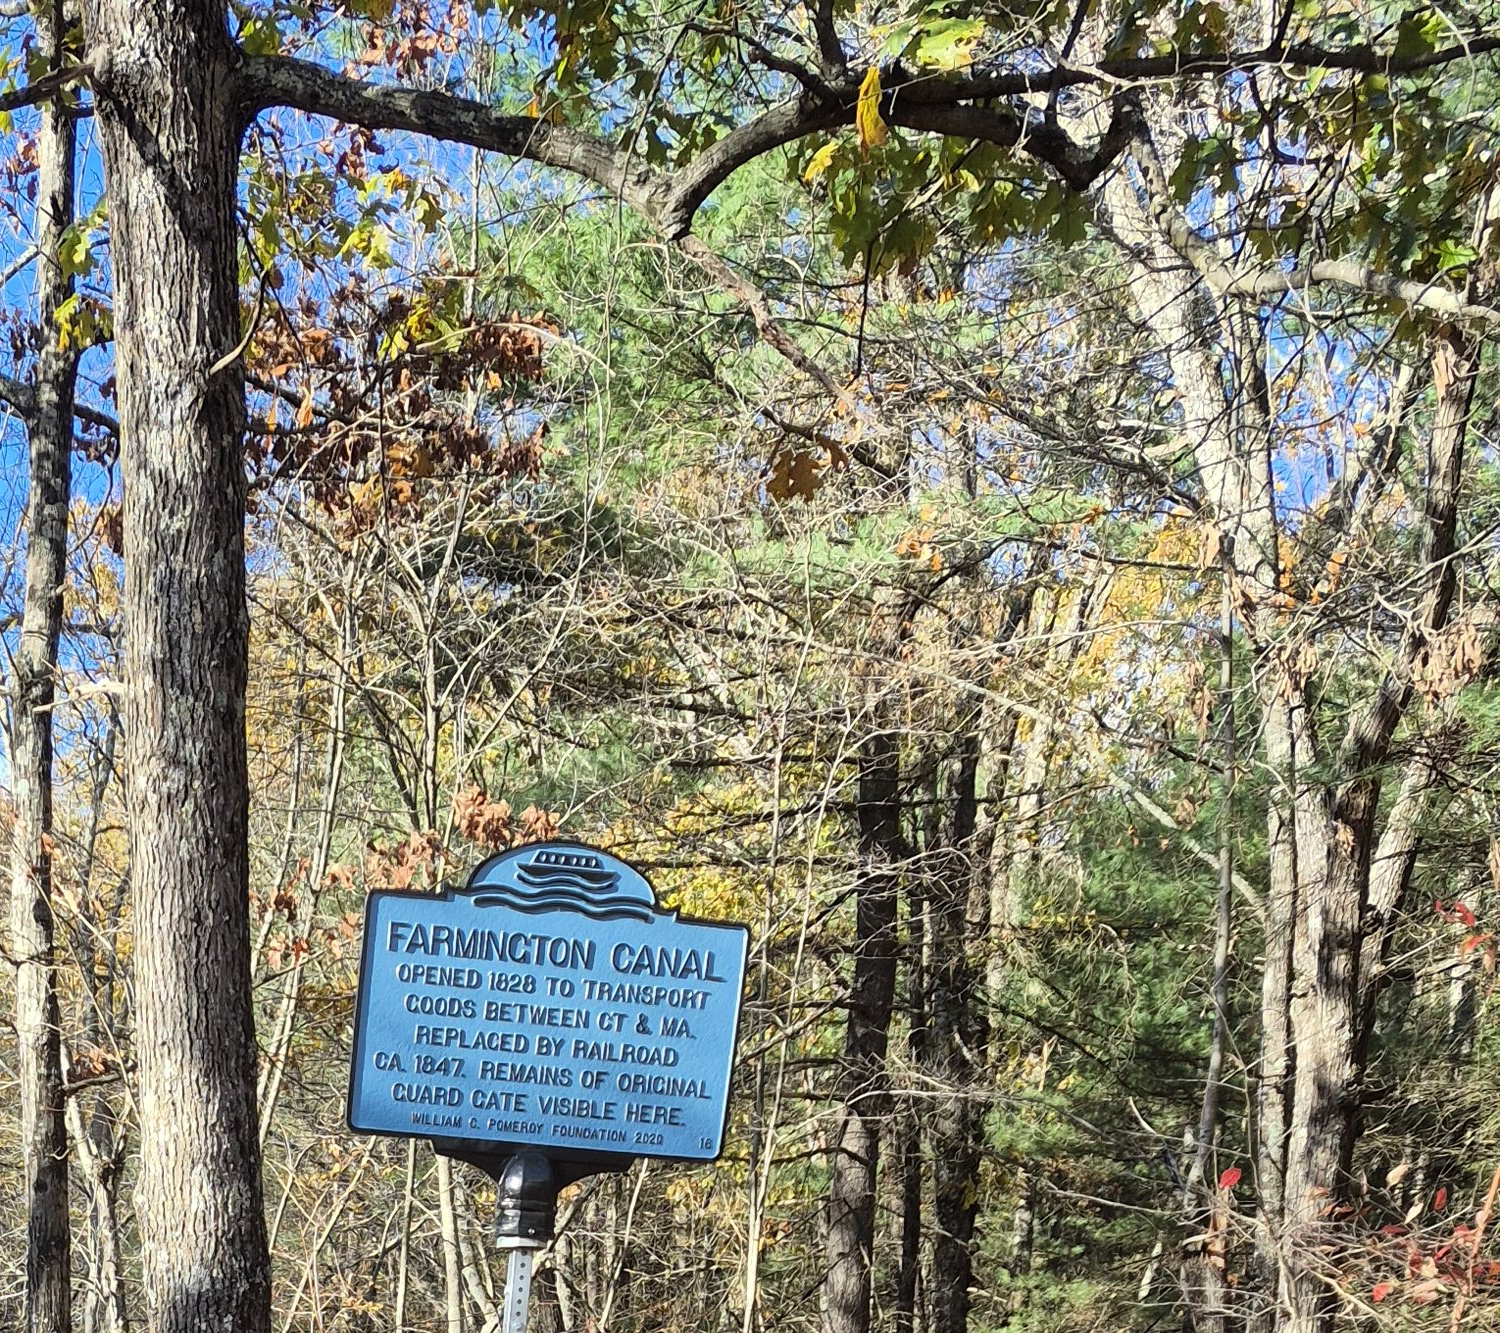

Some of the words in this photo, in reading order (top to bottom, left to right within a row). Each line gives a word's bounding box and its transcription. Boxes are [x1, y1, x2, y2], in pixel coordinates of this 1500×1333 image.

[387, 921, 595, 971] FARMINGTON
[611, 942, 727, 983] CANAL
[397, 963, 482, 989] OPENED
[488, 972, 536, 994] 1828
[546, 977, 575, 998] TO
[583, 979, 712, 1009] TRANSPORT
[405, 994, 477, 1018] GOODS
[484, 1002, 590, 1029] BETWEEN
[598, 1009, 627, 1032] CT
[636, 1014, 652, 1036] &
[661, 1017, 696, 1039] MA.
[415, 1025, 529, 1054] REPLACED
[536, 1038, 565, 1057] BY
[571, 1040, 679, 1067] RAILROAD
[375, 1051, 406, 1073] CA.
[414, 1055, 466, 1079] 1847.
[480, 1061, 573, 1087] REMAINS
[581, 1070, 609, 1089] OF
[617, 1073, 712, 1099] ORIGINAL
[392, 1083, 463, 1107] GUARD
[471, 1089, 528, 1112] GATE
[539, 1096, 615, 1120] VISIBLE
[626, 1105, 686, 1127] HERE.
[412, 1112, 462, 1128] WILLIAM
[488, 1118, 543, 1135] POMEROY
[552, 1124, 627, 1142] FOUNDATION
[635, 1132, 663, 1145] 2020
